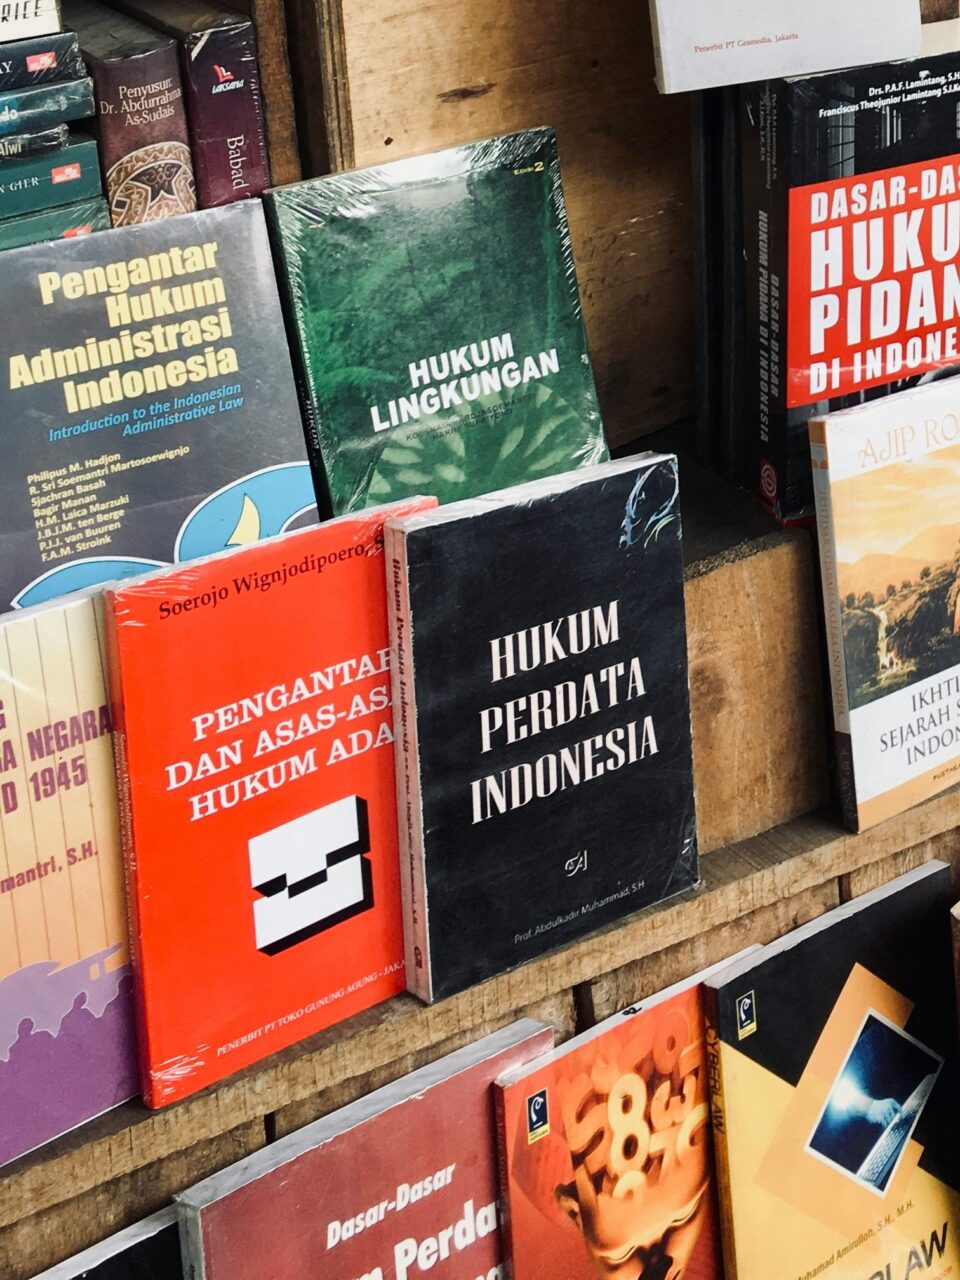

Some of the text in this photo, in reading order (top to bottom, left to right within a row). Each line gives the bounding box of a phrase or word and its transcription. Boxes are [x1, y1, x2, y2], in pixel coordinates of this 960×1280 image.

[100, 100, 118, 116] Dr.
[124, 106, 175, 126] As-Sudais
[818, 102, 858, 118] Franciscus
[860, 95, 901, 111] Theojunior
[902, 88, 940, 104] Lamintang
[227, 134, 246, 190] Babad
[38, 240, 218, 305] Pengantar
[105, 277, 226, 328] Hukum
[9, 308, 232, 389] Administrasi
[408, 332, 515, 389] HUKUM
[63, 346, 239, 414] Indonesia
[370, 349, 560, 433] LINGKUNGAN
[810, 360, 840, 396] DI
[48, 382, 241, 442] Introduction to the Indonesian
[122, 396, 244, 437] Administrative Law
[858, 428, 916, 468] AJIP
[40, 521, 121, 550] P.J.J. van Buuren
[159, 541, 370, 620] Soerojo Wignjodipoero,
[490, 599, 620, 685] HUKUM
[479, 656, 646, 754] PERDATA
[879, 709, 951, 753] SEJARAH
[28, 704, 112, 765] NEGARA
[31, 757, 86, 799] 1945
[164, 737, 243, 792] DAN
[187, 749, 318, 823] HUKUM
[471, 715, 658, 825] INDONESIA
[66, 845, 99, 870] S.H.
[514, 931, 534, 945] Prof.
[535, 909, 579, 938] Abdulkadir
[581, 890, 630, 918] Muhammad,
[217, 973, 378, 1056] PENERBIT PT TOKO GUNUNG AGUNG
[706, 1025, 725, 1135] CYBERLAW
[326, 1162, 456, 1250] Dasar-Dasar
